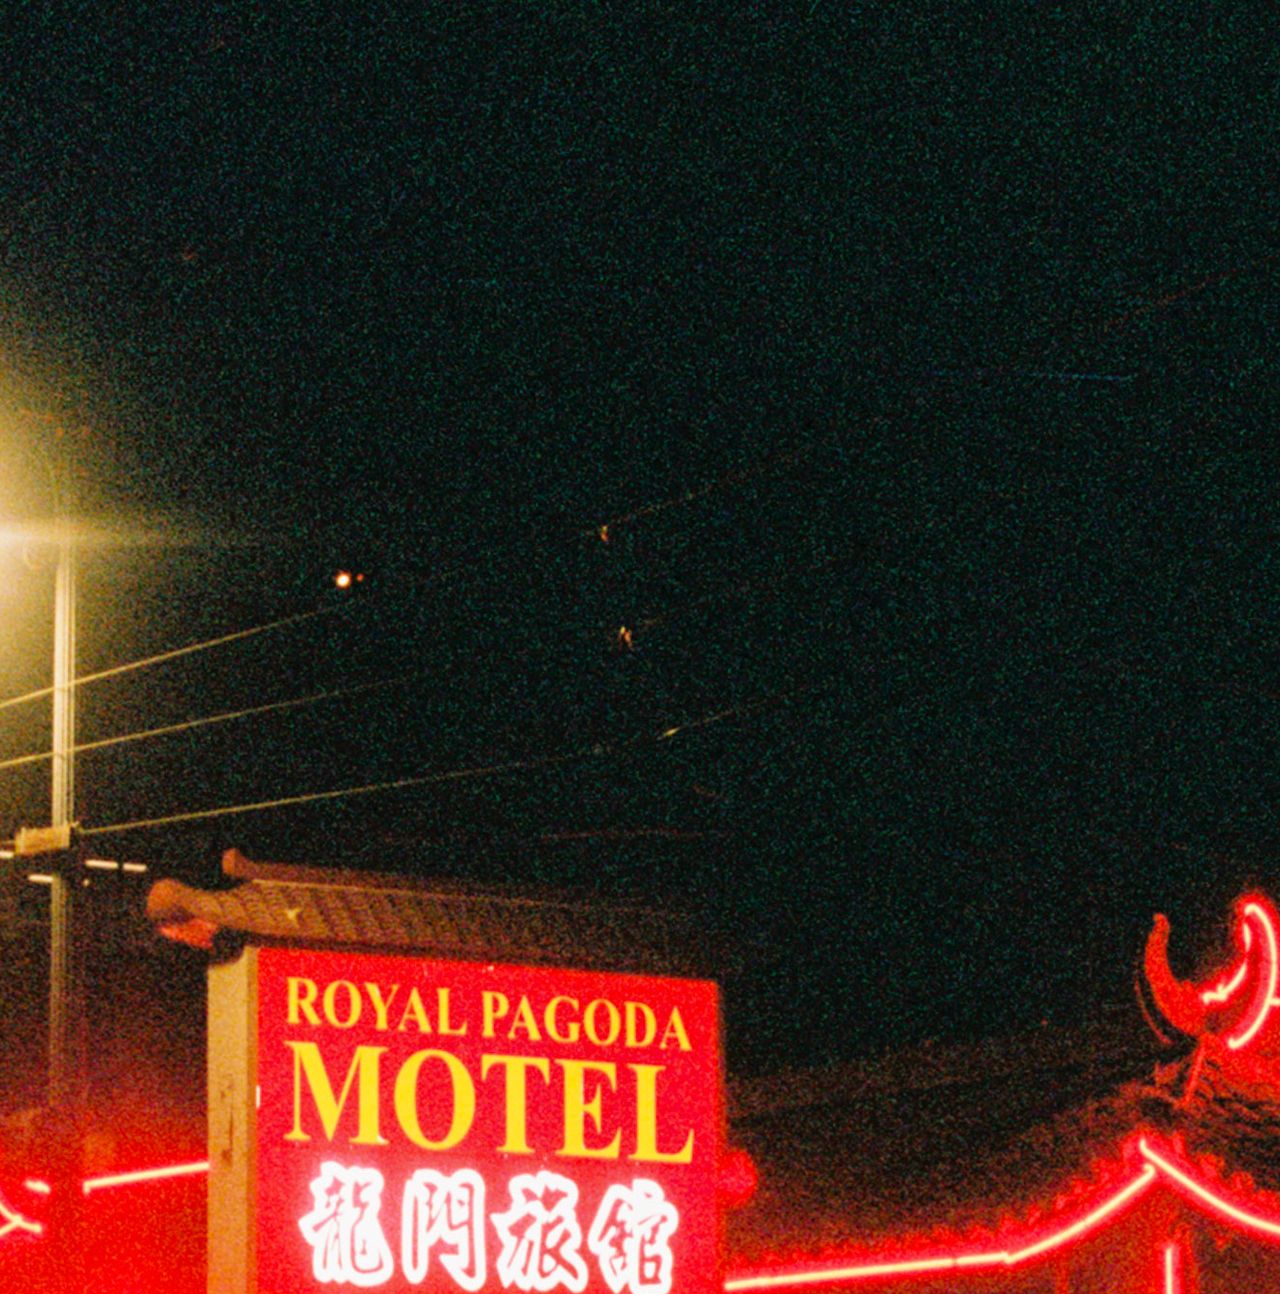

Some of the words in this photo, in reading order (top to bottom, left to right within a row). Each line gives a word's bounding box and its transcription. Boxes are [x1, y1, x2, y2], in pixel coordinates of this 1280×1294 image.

[286, 976, 468, 1038] ROYAL
[481, 990, 694, 1052] PAGODA
[283, 1039, 696, 1165] MOTEL
